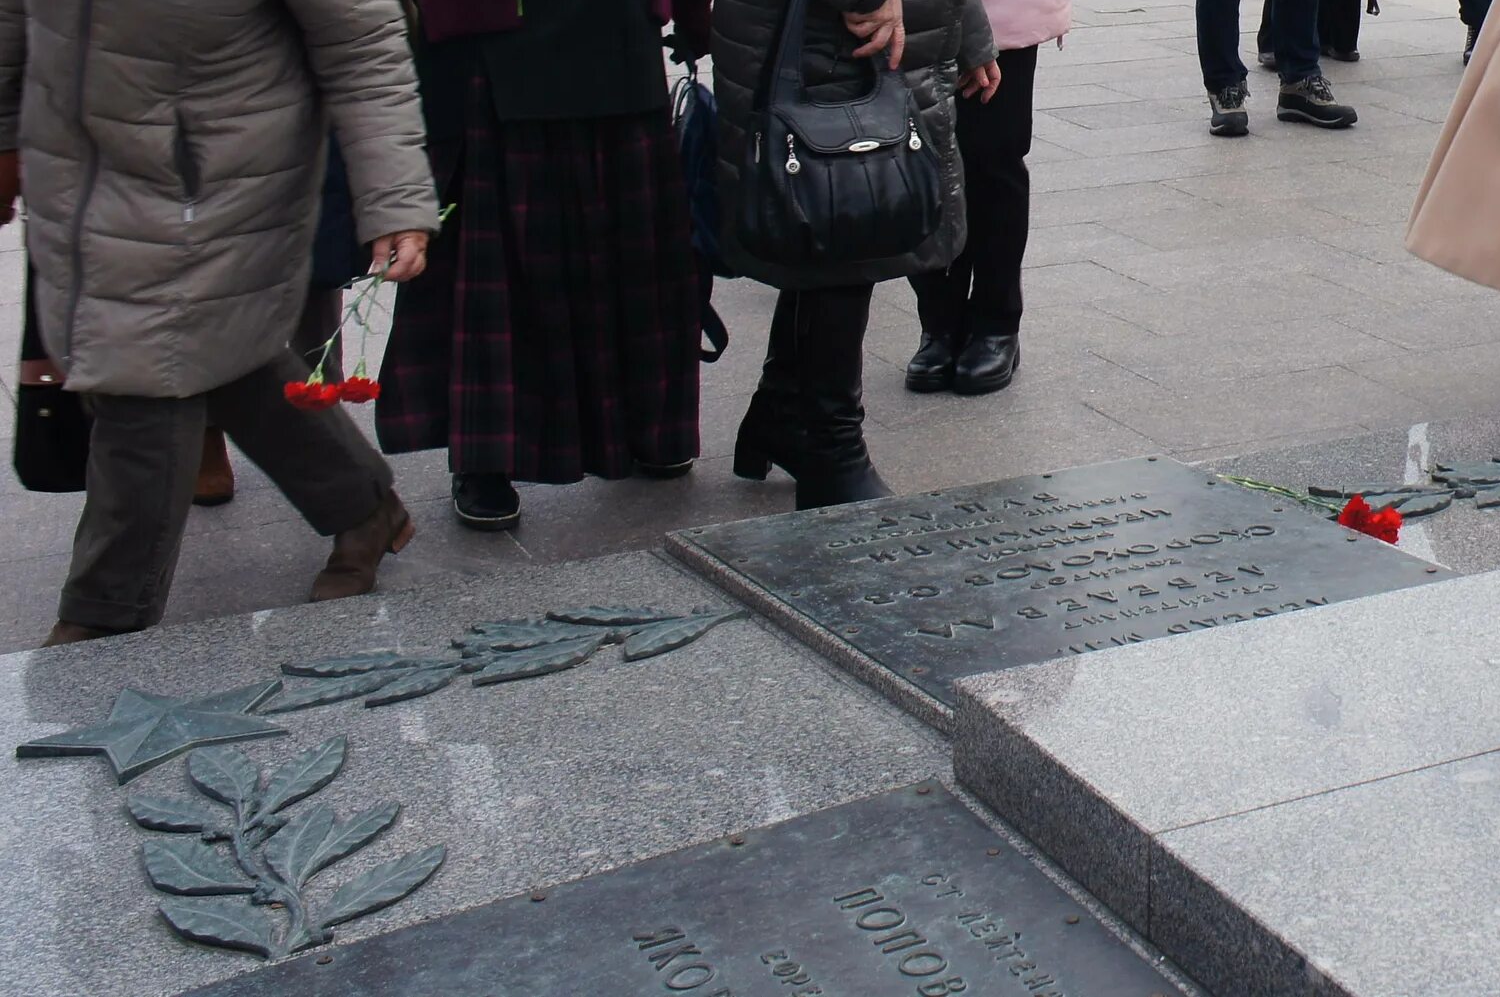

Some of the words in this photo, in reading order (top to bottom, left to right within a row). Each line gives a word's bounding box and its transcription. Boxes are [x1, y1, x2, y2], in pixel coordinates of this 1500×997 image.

[964, 524, 1276, 586] СКОРОХОДОВ
[977, 531, 1115, 562] РЯДОВОЙ
[1030, 557, 1183, 590] ЕФРЕЙТОР
[1016, 564, 1265, 619] ЛЕБЕДЕВ
[834, 887, 968, 997] ПОПОВ
